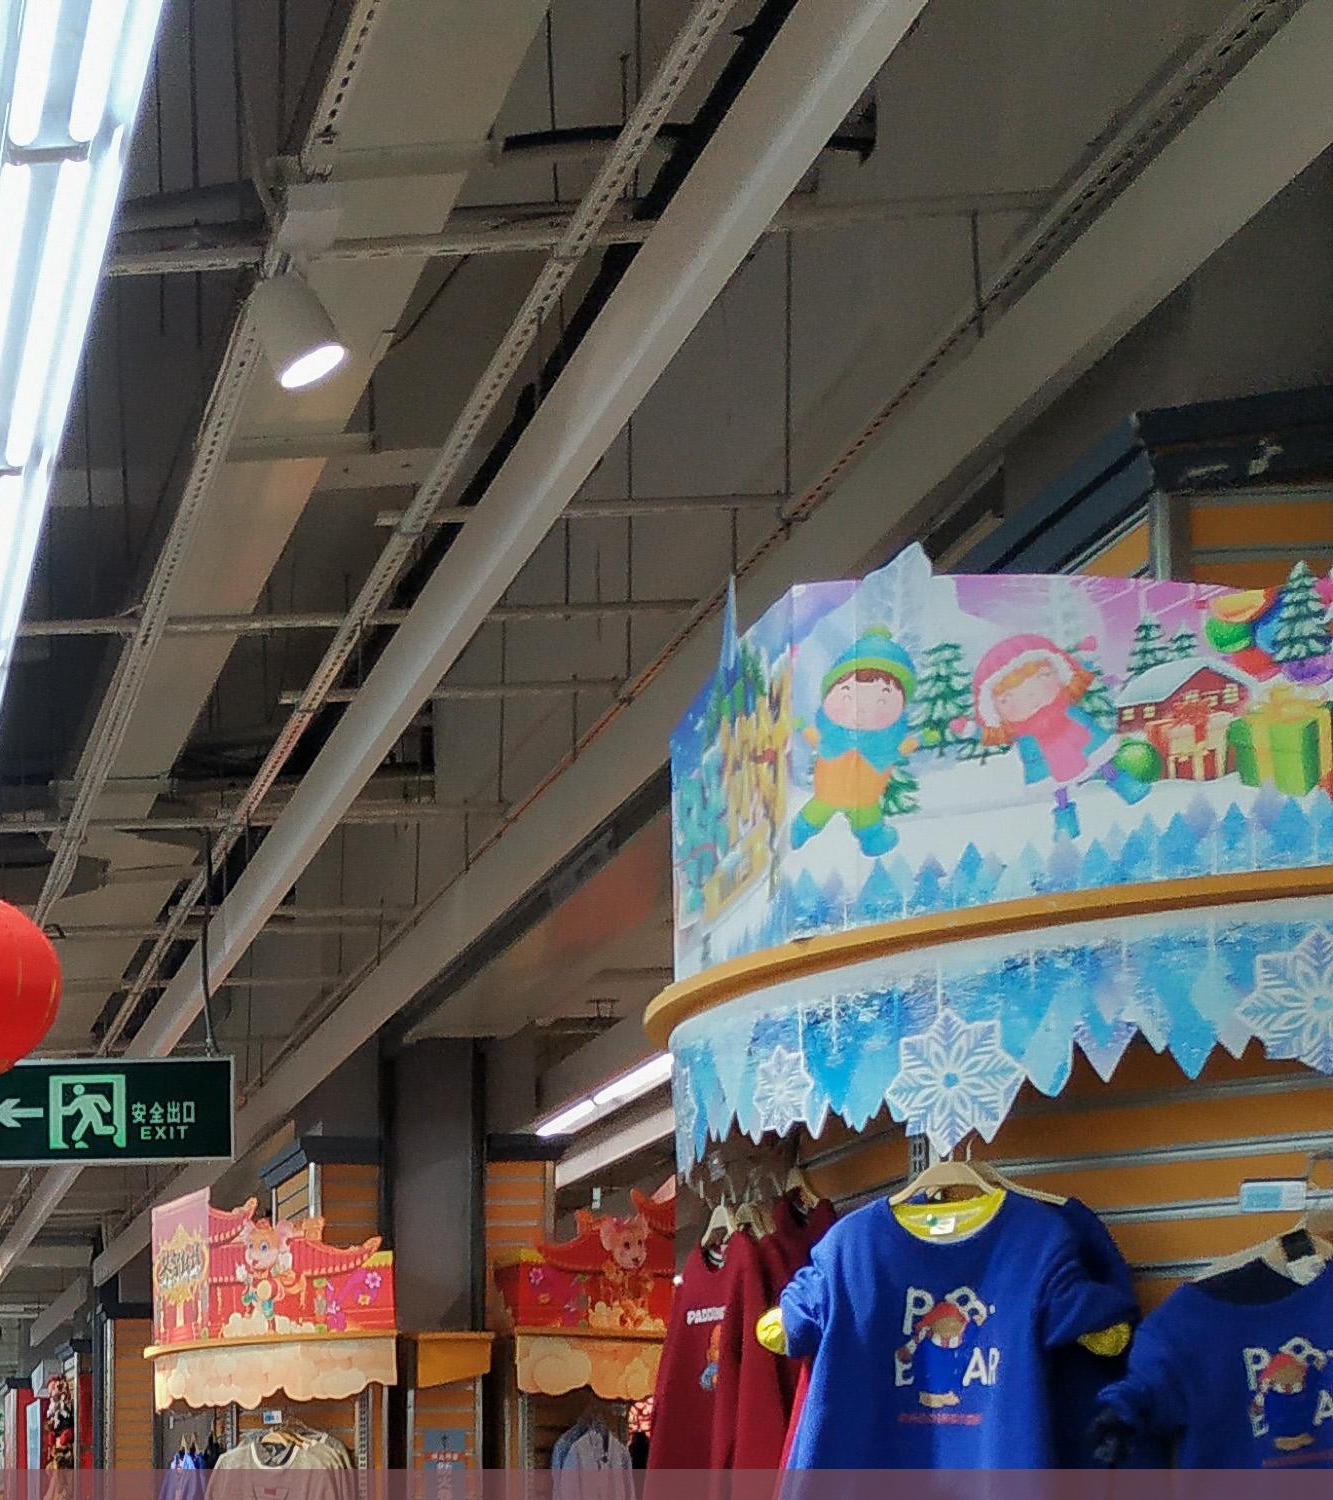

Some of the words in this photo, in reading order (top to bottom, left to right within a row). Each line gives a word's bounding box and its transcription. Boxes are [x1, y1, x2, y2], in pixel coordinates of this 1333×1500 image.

[132, 1101, 195, 1124] 安全出口
[140, 1125, 189, 1140] EXIT
